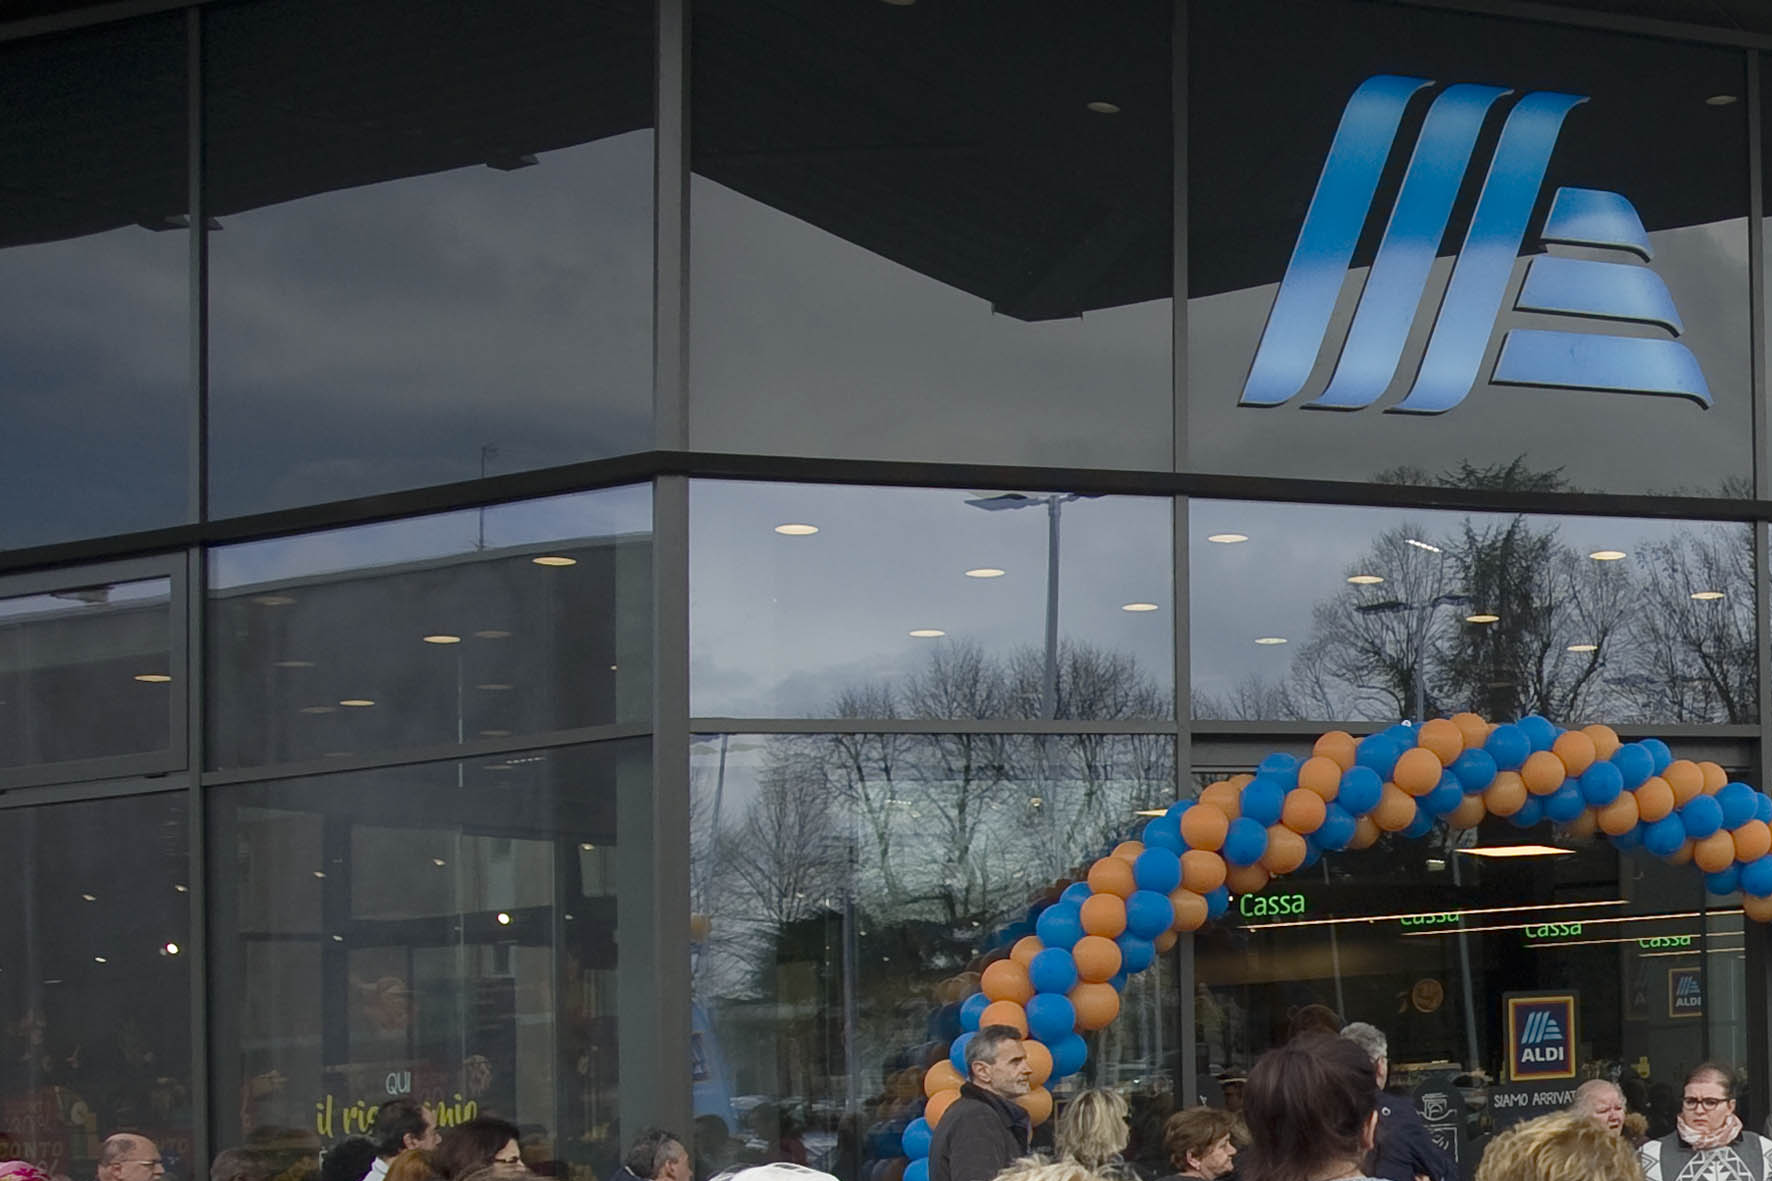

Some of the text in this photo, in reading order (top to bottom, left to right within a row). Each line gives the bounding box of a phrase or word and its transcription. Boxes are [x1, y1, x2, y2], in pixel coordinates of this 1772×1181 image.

[1240, 893, 1306, 917] Cassa
[1521, 1047, 1565, 1062] ALDI
[385, 1071, 412, 1095] QUI
[1494, 1090, 1577, 1108] SIAMO ARRIVAT
[316, 1095, 335, 1138] il
